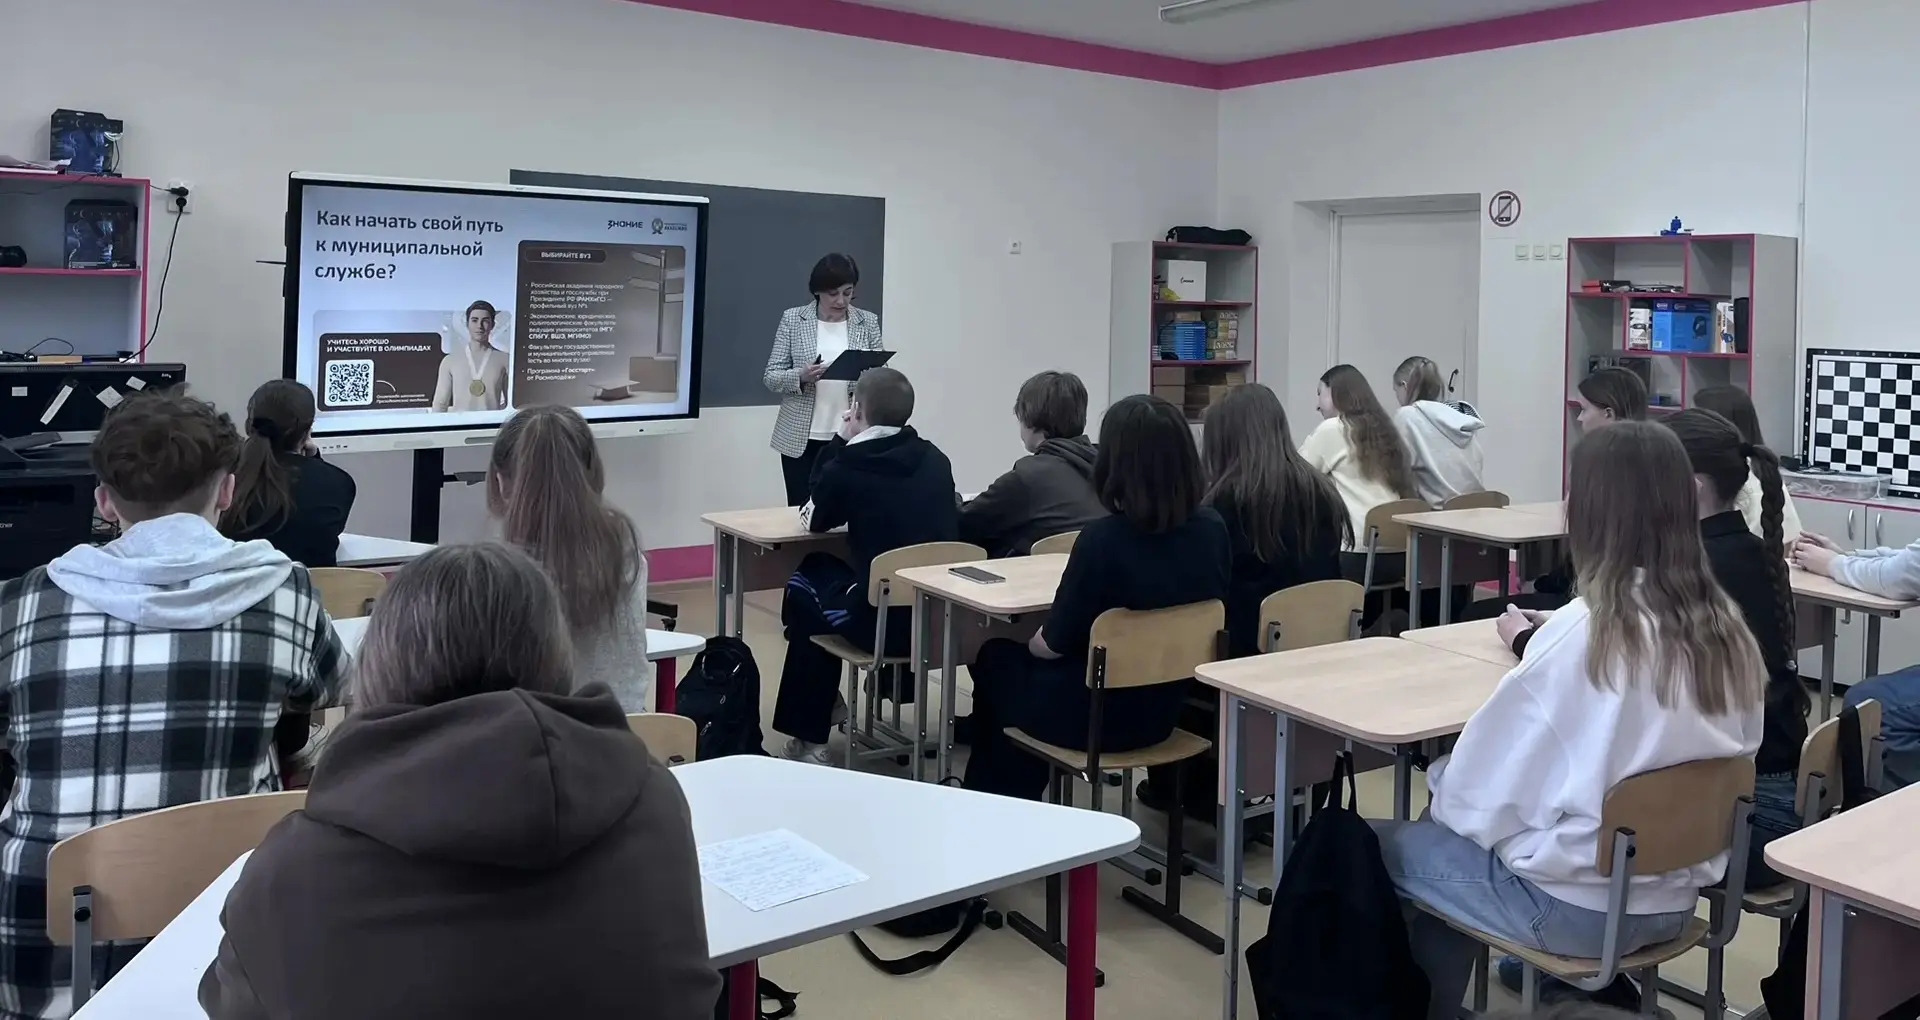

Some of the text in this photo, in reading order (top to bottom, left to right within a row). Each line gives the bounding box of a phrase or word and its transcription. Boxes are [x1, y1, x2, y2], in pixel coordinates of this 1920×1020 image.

[316, 210, 504, 235] Как начать свой путь
[316, 240, 483, 256] к муниципальной
[314, 263, 396, 282] службе?
